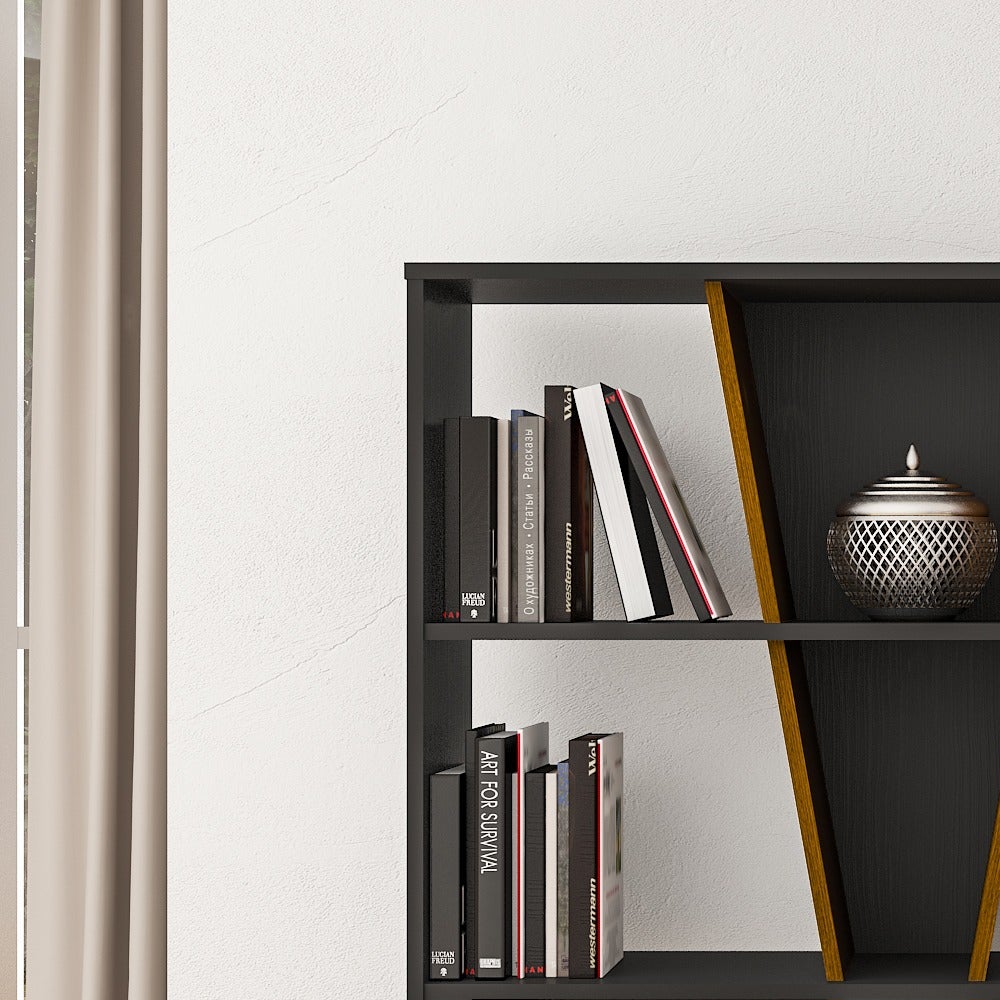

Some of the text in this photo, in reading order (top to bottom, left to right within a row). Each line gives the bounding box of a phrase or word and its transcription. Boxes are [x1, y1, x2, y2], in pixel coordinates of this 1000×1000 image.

[523, 428, 535, 480] Рассказы
[523, 494, 535, 531] Статьи
[522, 543, 538, 606] художниках
[480, 751, 498, 874] ART FOR SURVIVAL
[589, 878, 597, 969] westermann
